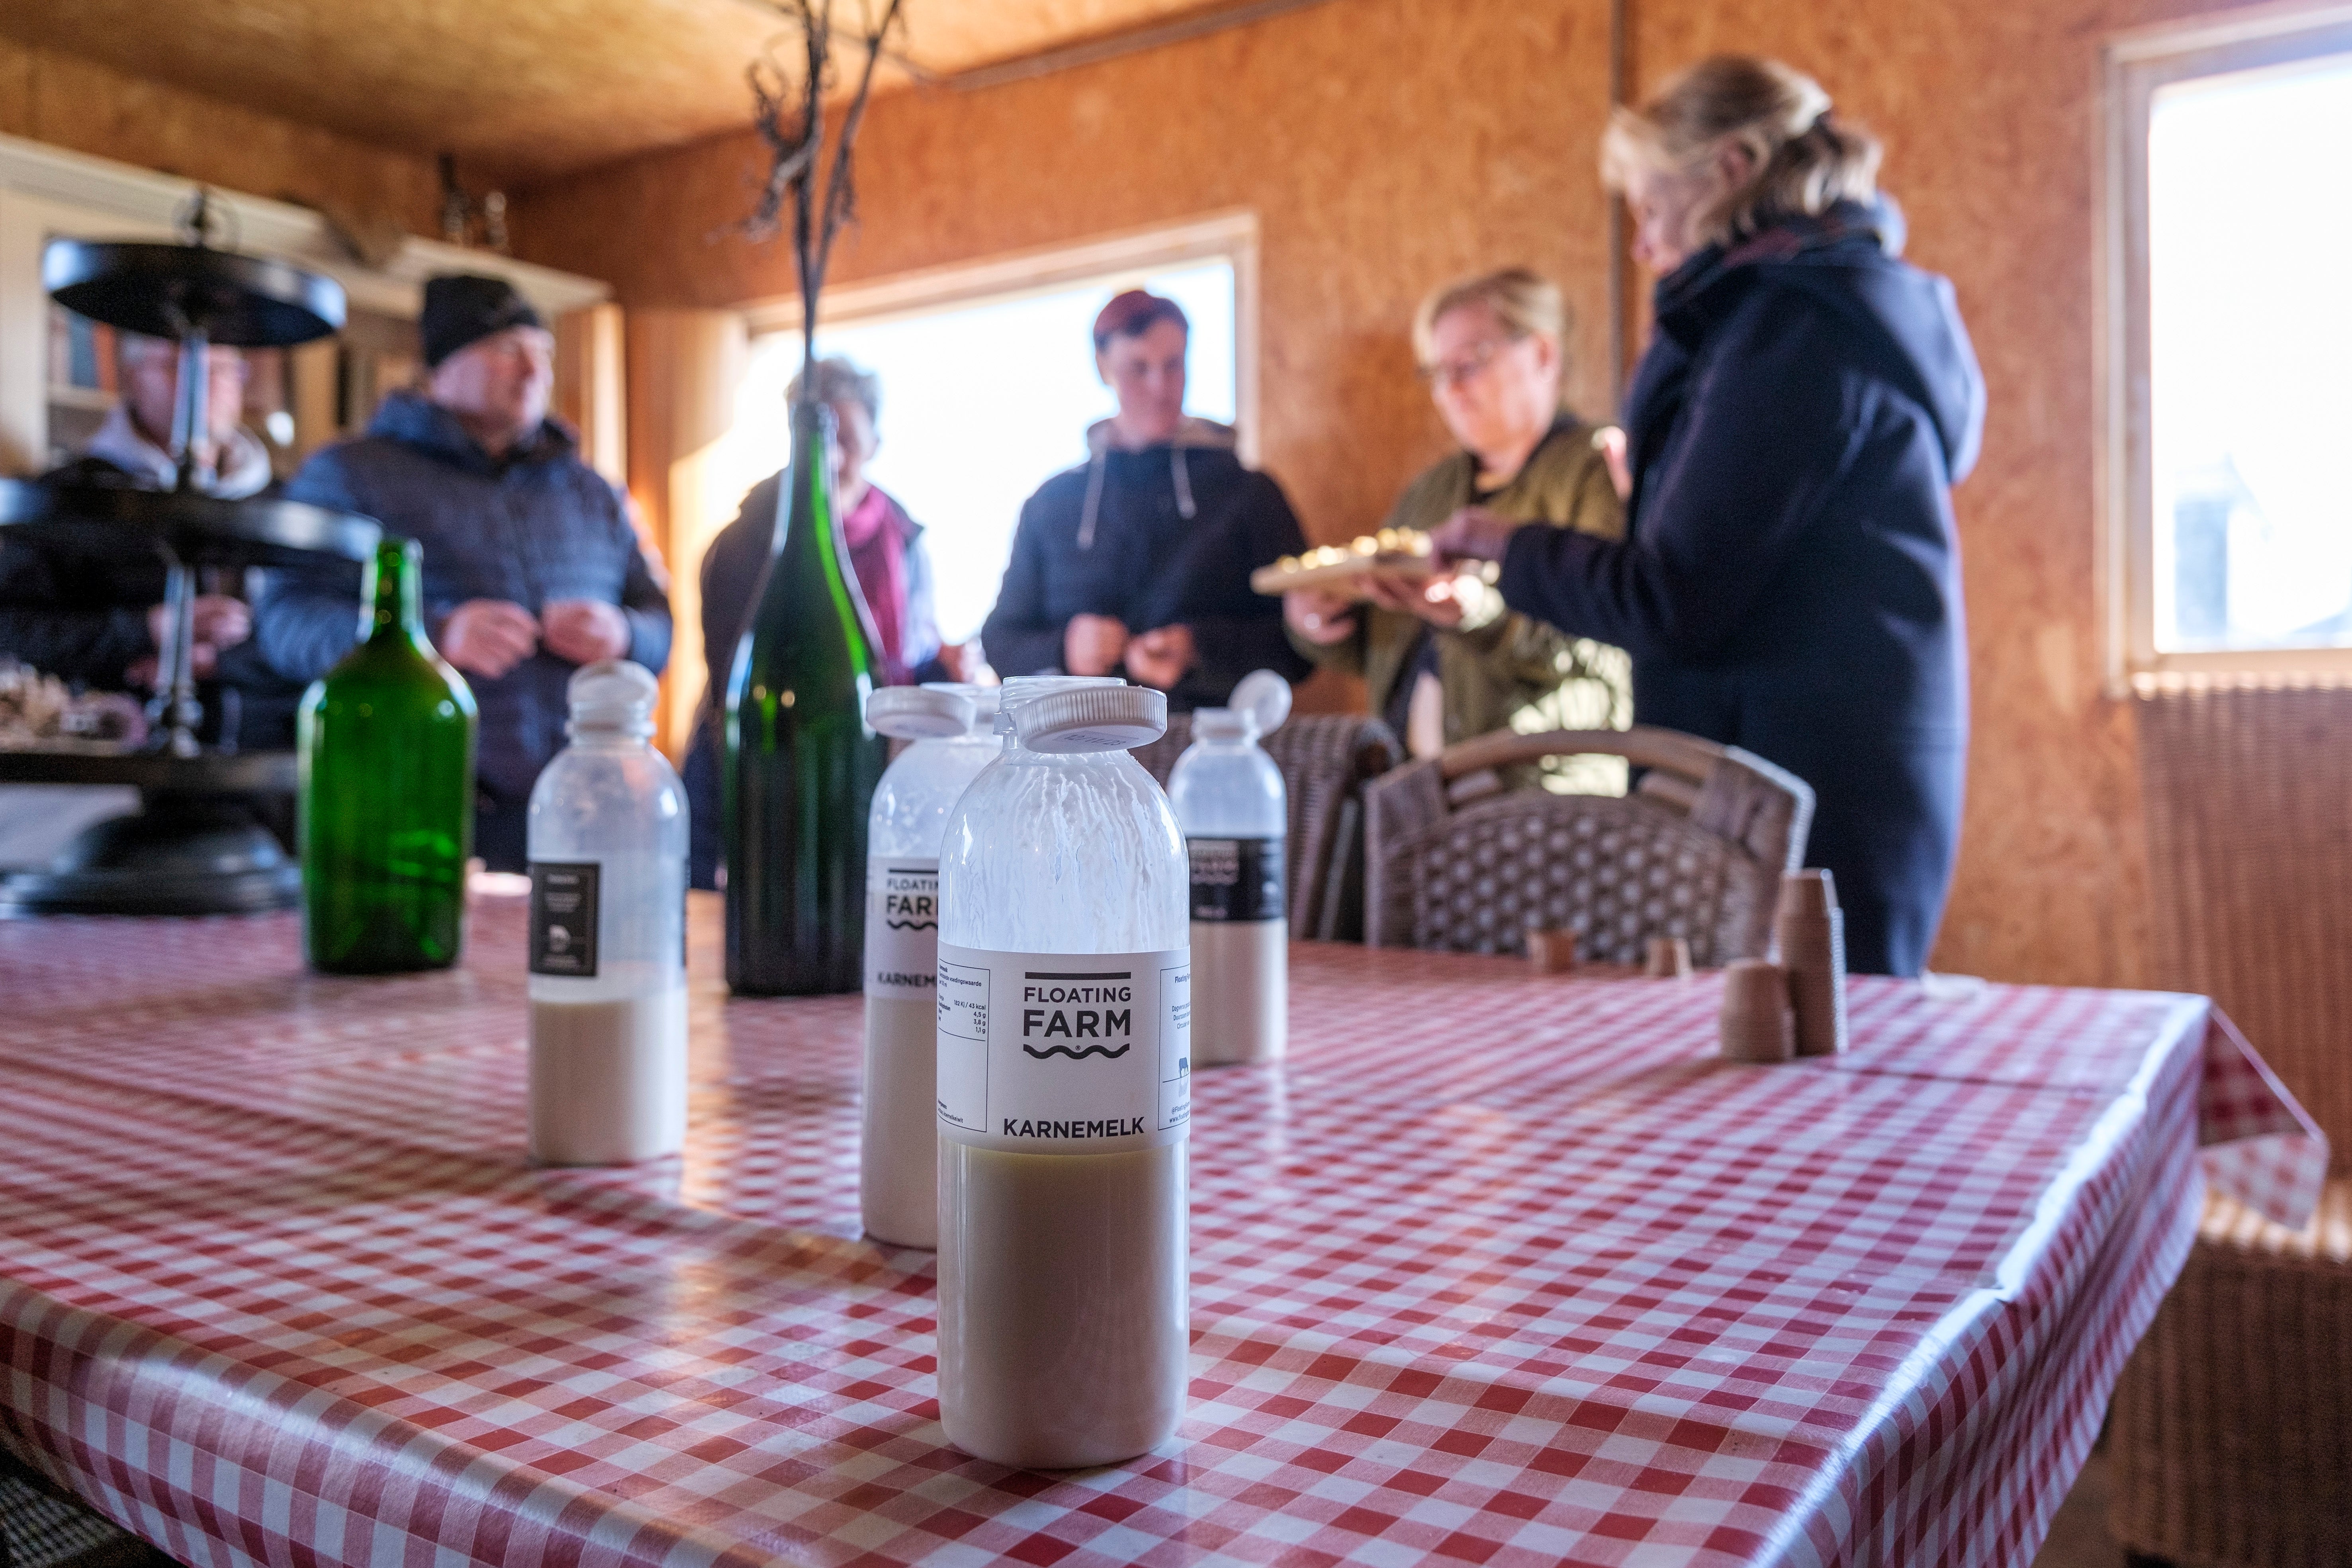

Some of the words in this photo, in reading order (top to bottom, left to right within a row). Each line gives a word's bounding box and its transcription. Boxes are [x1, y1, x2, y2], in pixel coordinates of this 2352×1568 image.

[886, 878, 938, 890] FLOATI
[887, 895, 938, 915] FAR
[878, 972, 937, 987] KARNEM
[1024, 987, 1131, 1003] FLOATING
[1023, 1009, 1130, 1037] FARM
[1004, 1116, 1145, 1138] KARNEMELK
